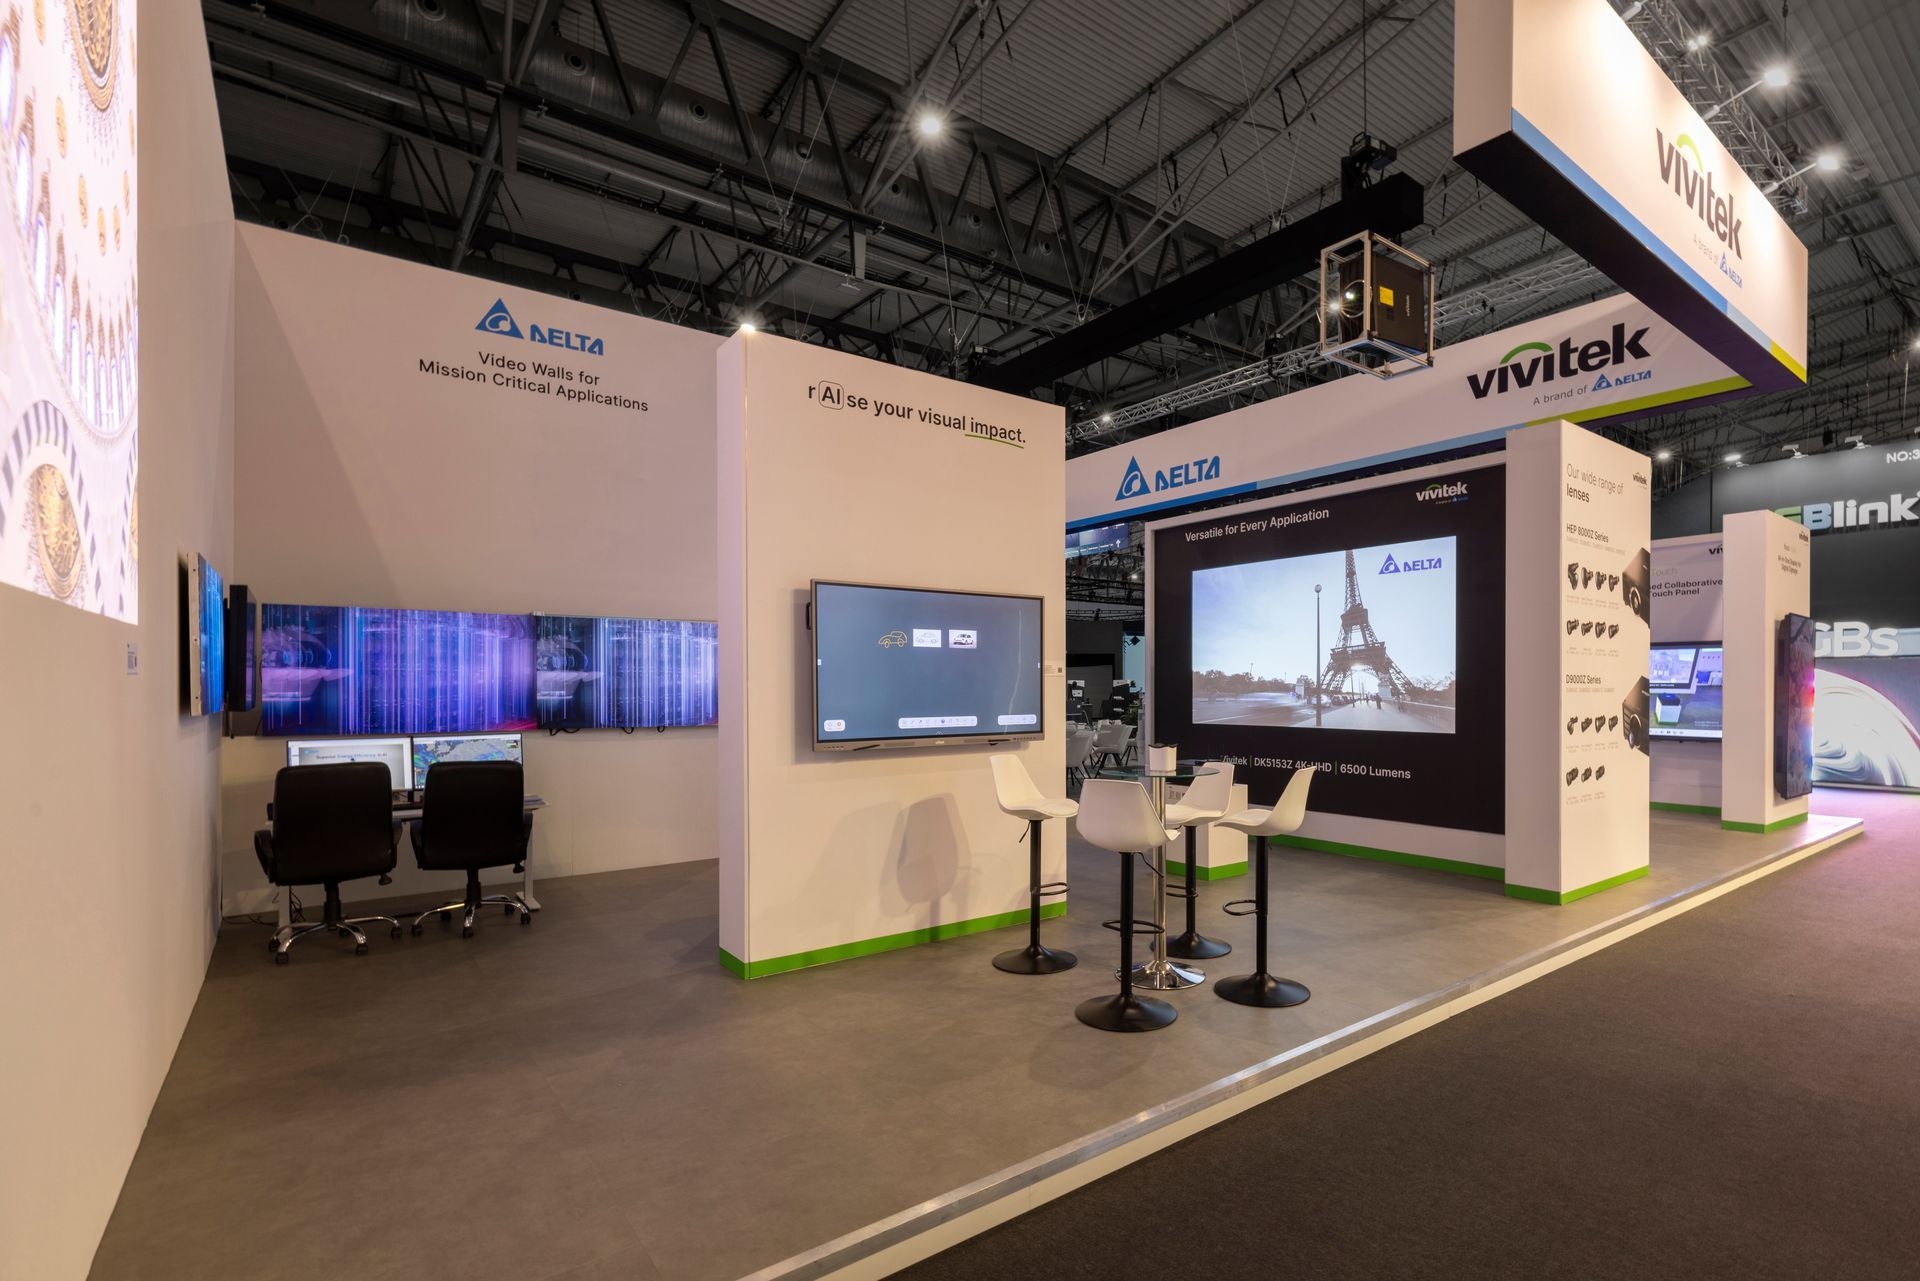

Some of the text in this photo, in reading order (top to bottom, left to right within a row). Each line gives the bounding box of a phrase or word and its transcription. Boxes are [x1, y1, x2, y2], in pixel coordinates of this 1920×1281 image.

[1656, 128, 1743, 260] vivitek
[530, 323, 604, 356] DELTA
[478, 351, 601, 386] Video Walls for
[1467, 323, 1651, 399] vivitek
[418, 358, 649, 412] Mission Critical Applications
[1533, 369, 1652, 405] A brand of DELTA
[873, 400, 914, 418] your
[918, 407, 966, 431] visual
[970, 417, 1026, 443] impact.
[1154, 455, 1220, 492] DELTA
[1566, 464, 1580, 479] Our
[1581, 472, 1597, 486] wide
[1598, 477, 1616, 494] range
[1415, 480, 1468, 502] vivitek
[1566, 483, 1590, 503] lenses
[1185, 508, 1330, 543] Versatile for Every Application
[1403, 558, 1442, 574] DELTA
[1650, 578, 1723, 590] ed Collaborative
[1675, 588, 1700, 596] Panel
[1587, 675, 1602, 684] Series
[1254, 757, 1293, 769] DK5153Z
[1340, 764, 1367, 775] 6500
[1369, 766, 1412, 779] Lumens
